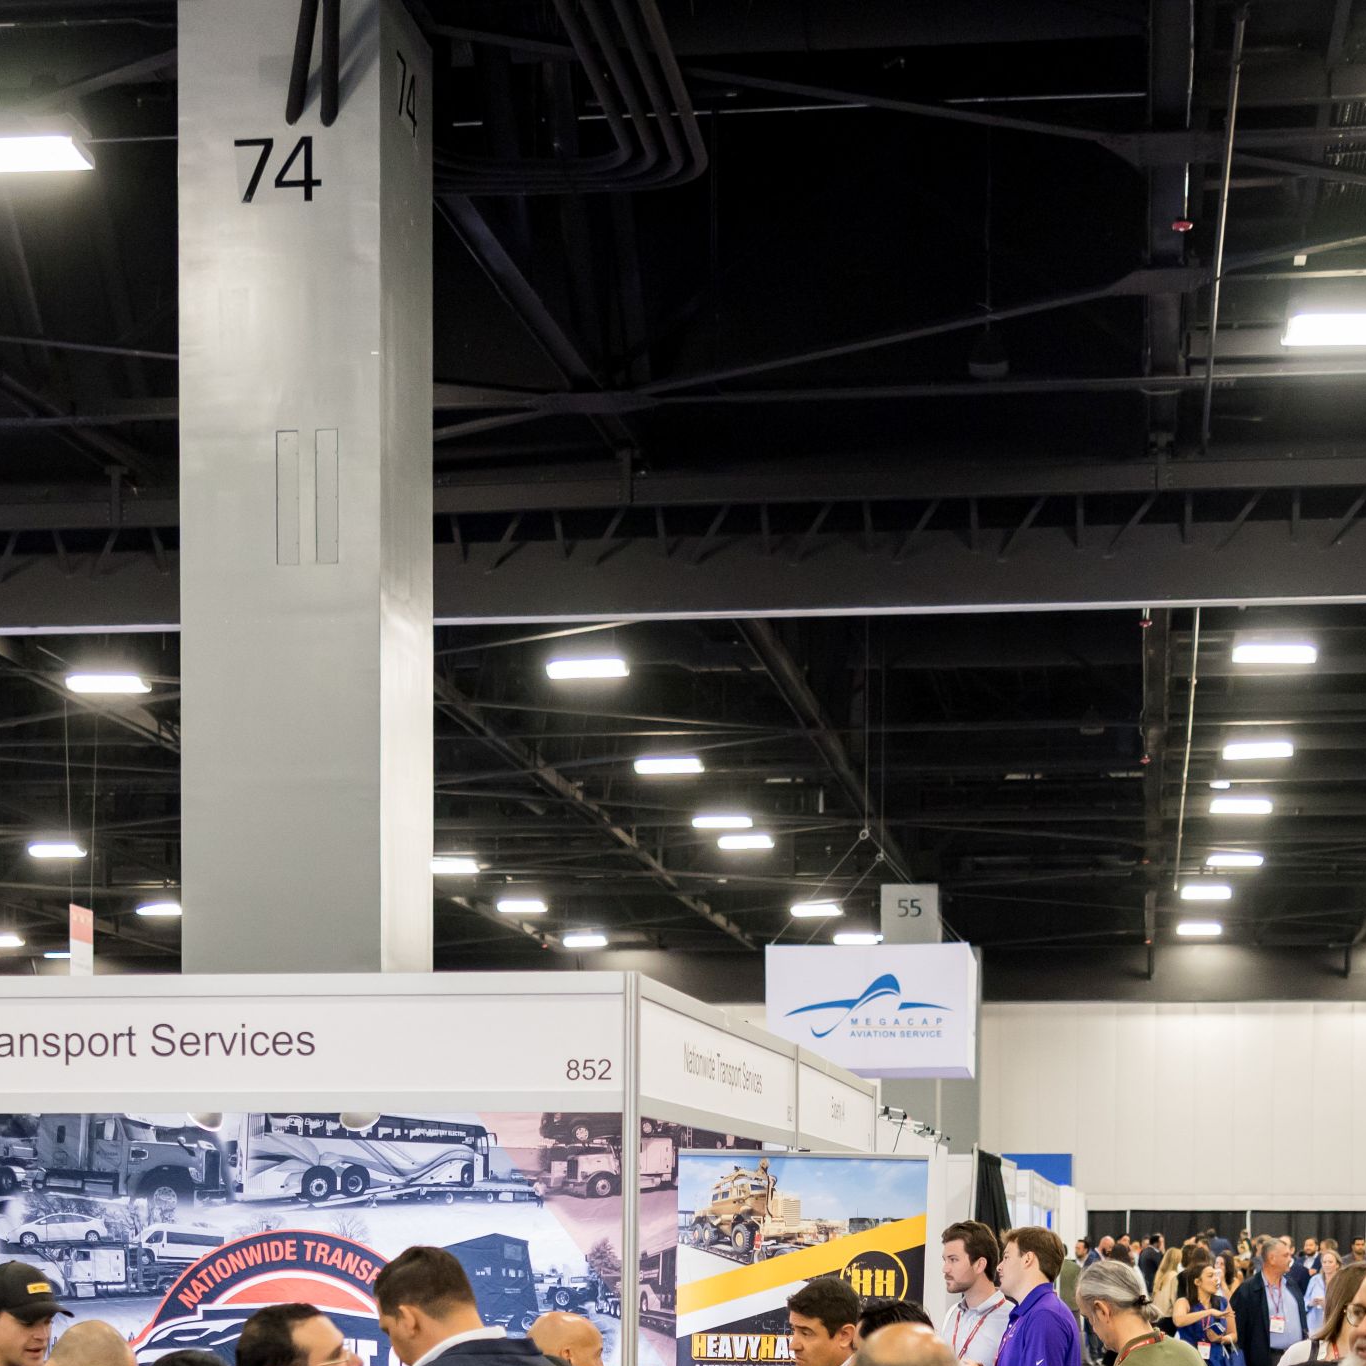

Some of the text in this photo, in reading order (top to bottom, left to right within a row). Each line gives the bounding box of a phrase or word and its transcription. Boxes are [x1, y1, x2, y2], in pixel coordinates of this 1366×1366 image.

[234, 136, 322, 203] 74
[897, 899, 922, 917] 55
[150, 1023, 316, 1058] Services
[850, 1030, 942, 1038] AVIATION SERVICE
[566, 1058, 612, 1081] 852
[684, 1041, 763, 1095] Nationwide Transport Services
[177, 1239, 297, 1310] NATIONWIDE
